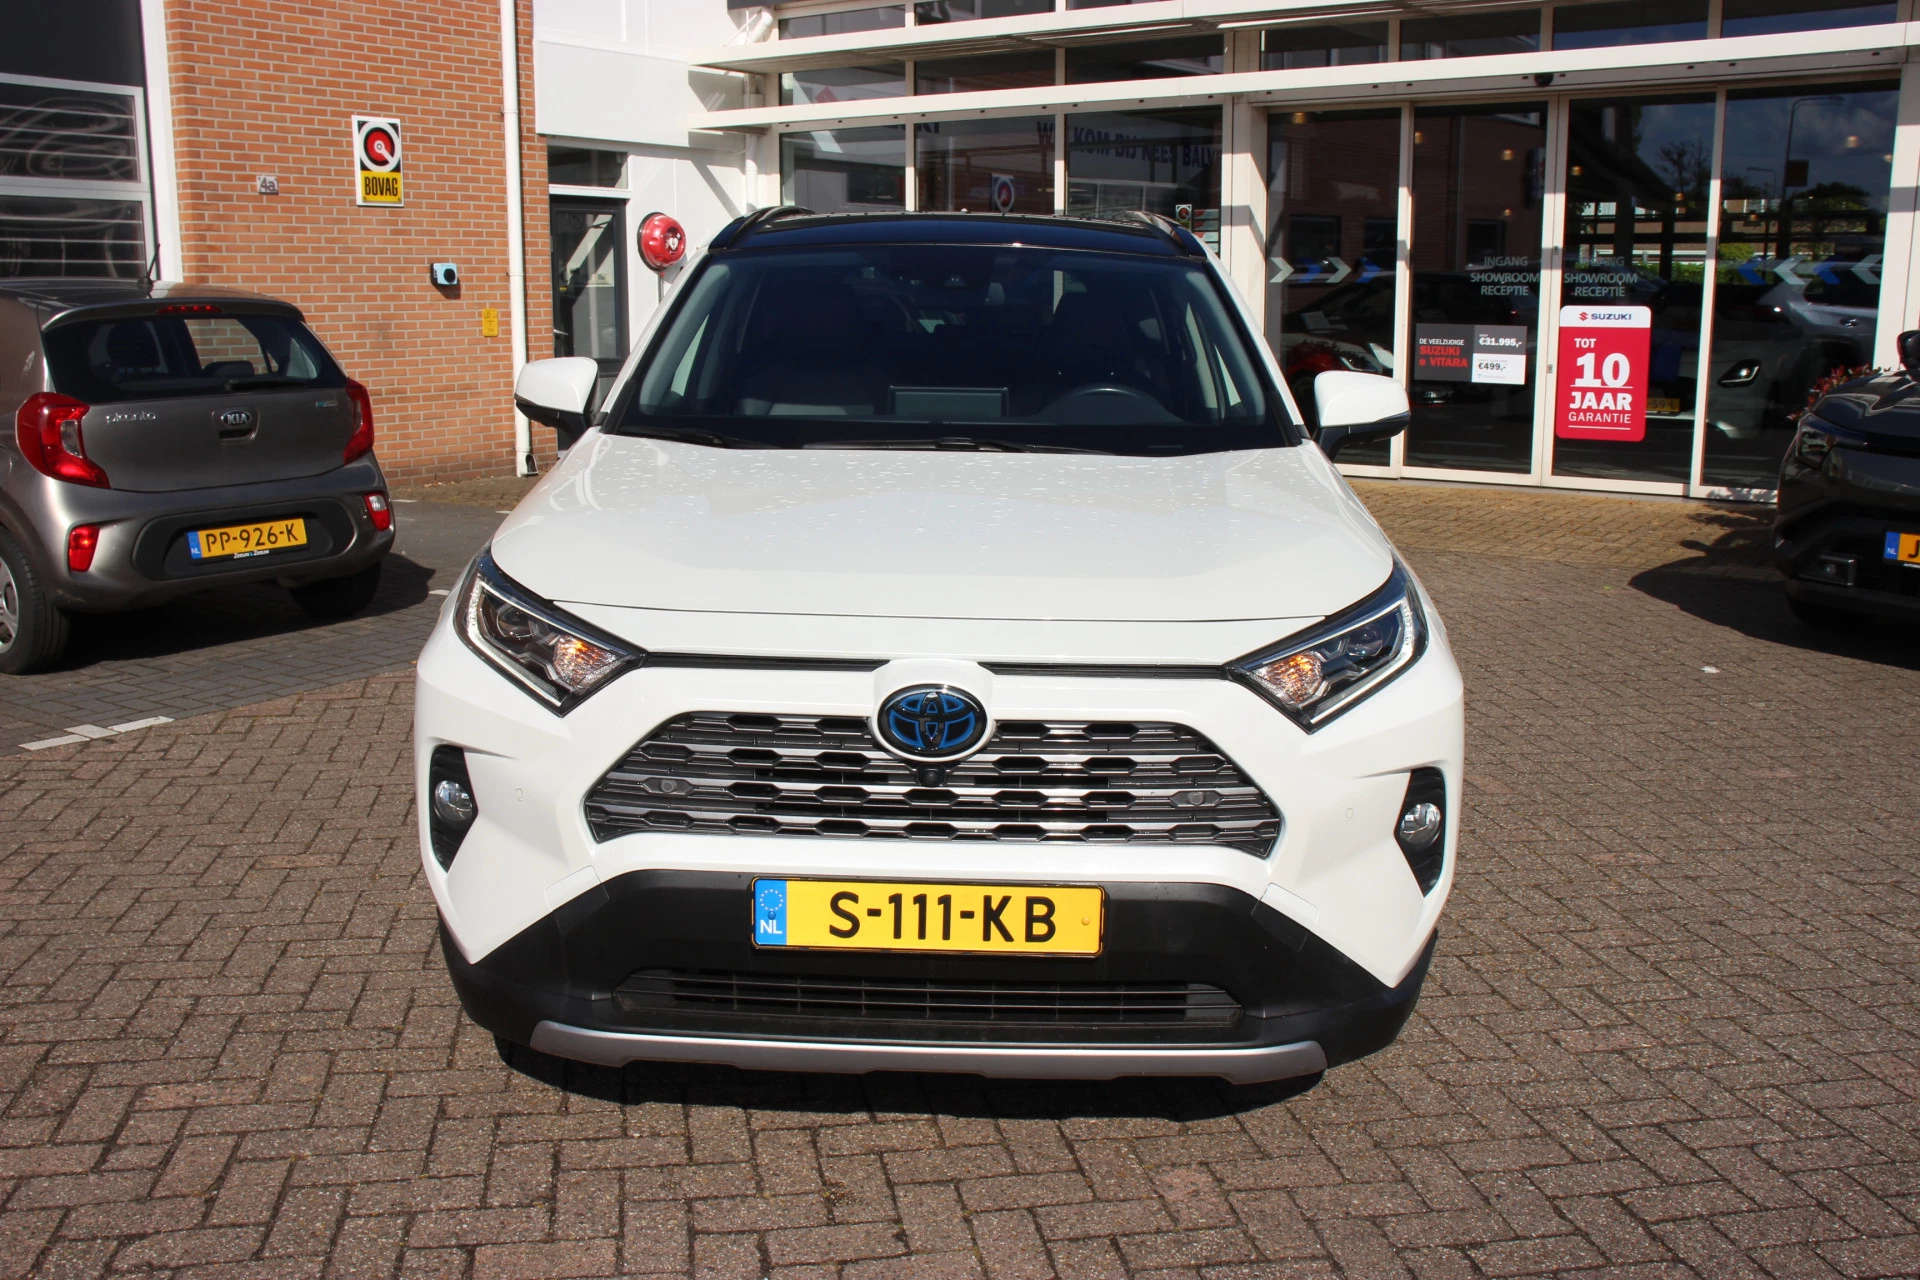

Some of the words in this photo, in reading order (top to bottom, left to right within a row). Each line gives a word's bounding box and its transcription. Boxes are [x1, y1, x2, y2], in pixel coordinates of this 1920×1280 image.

[260, 177, 276, 192] 4a
[364, 176, 399, 197] BOVAG
[1484, 256, 1528, 267] INGANG
[1579, 256, 1625, 267] GANG
[1470, 272, 1540, 283] SHOWROOM
[1564, 272, 1638, 284] SHOWROOM
[1480, 285, 1529, 296] RECEPTIE
[1574, 286, 1626, 297] RECEPTIE
[1590, 313, 1632, 321] SUZUKI
[1428, 338, 1465, 346] VEELZIJDIGE
[1573, 337, 1597, 349] TOT
[1419, 346, 1461, 356] SUZUKI
[1429, 357, 1469, 368] VITARA
[1478, 362, 1507, 372] €499,-
[1574, 352, 1631, 388] 10
[1569, 391, 1633, 411] JAAR
[226, 413, 249, 425] KIA
[1568, 411, 1632, 424] GARANTIE
[191, 547, 201, 555] NL
[205, 522, 299, 553] PP-926-K
[759, 919, 783, 935] NL
[828, 890, 1057, 944] S-111-KB
